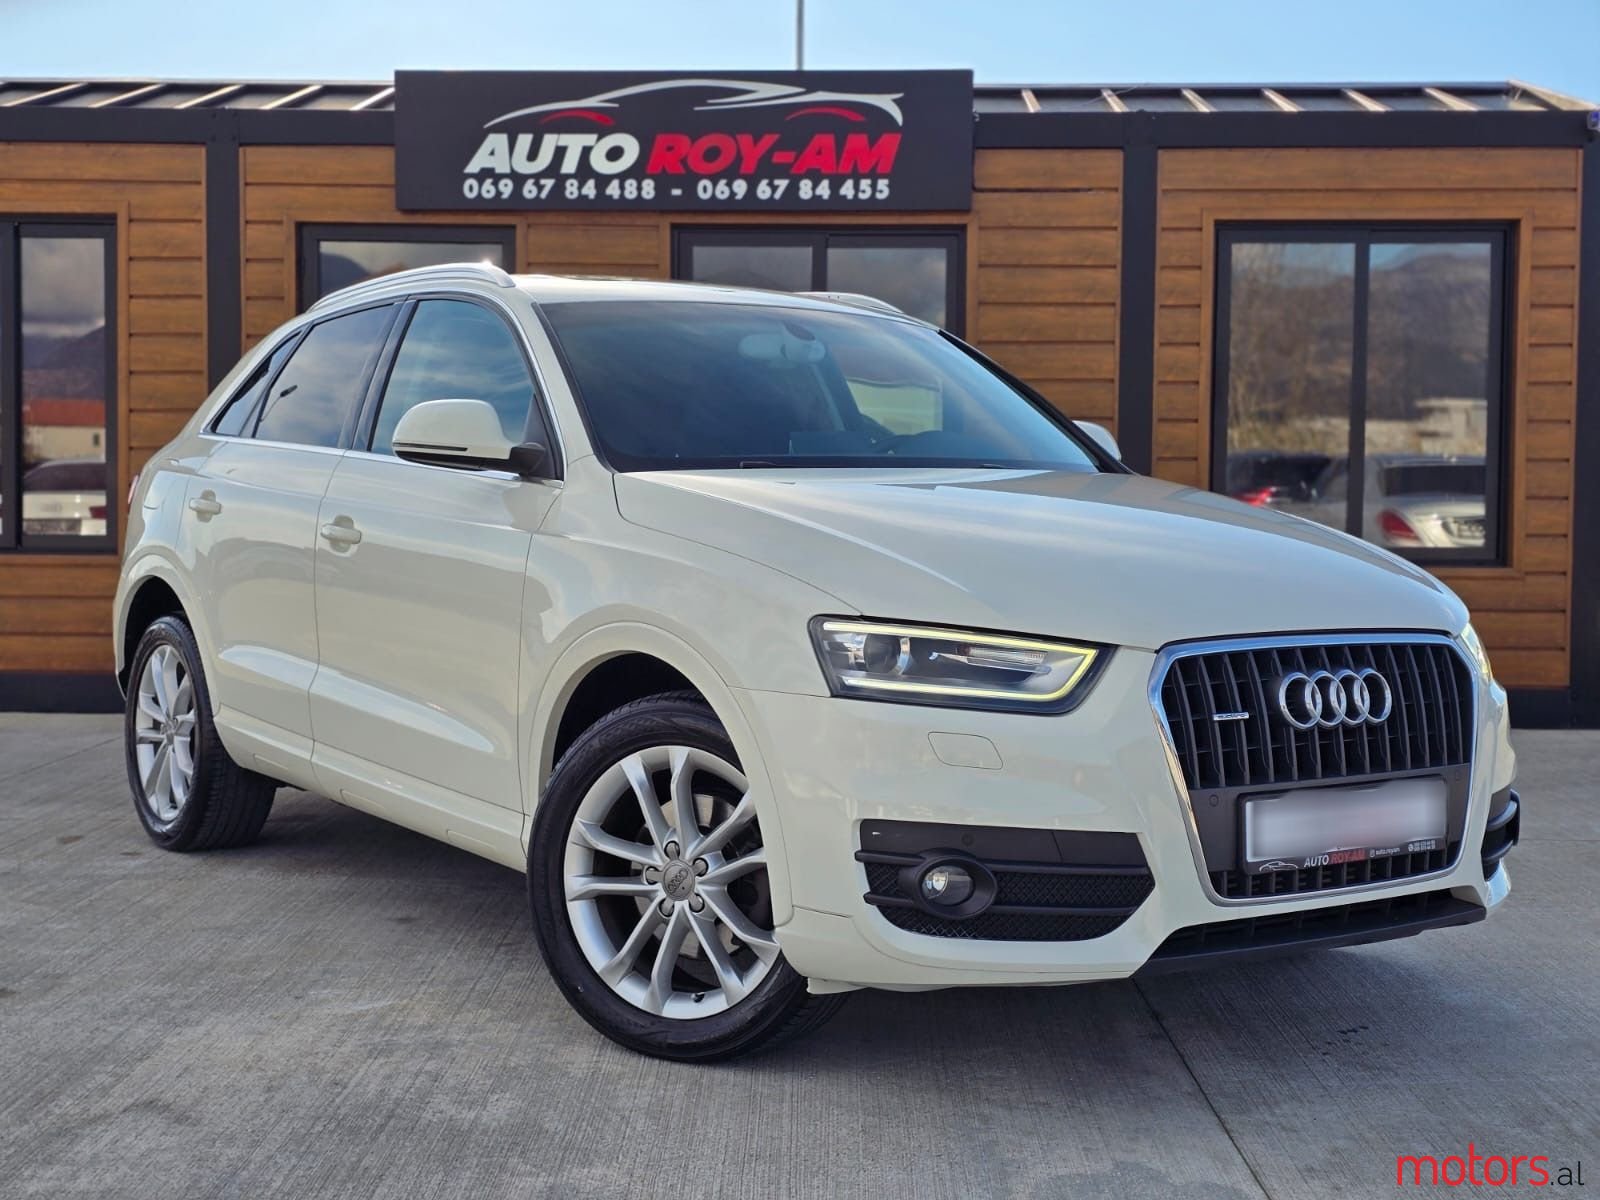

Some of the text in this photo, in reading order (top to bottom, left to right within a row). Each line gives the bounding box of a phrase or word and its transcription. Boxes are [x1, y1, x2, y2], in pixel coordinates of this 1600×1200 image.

[463, 132, 902, 175] AUTO ROY-AM
[463, 178, 514, 200] 069
[522, 178, 556, 200] 67
[565, 178, 597, 200] 84
[605, 178, 656, 200] 488
[697, 178, 748, 200] 069
[756, 178, 790, 200] 67
[798, 178, 831, 200] 84
[839, 178, 890, 200] 455
[1304, 854, 1329, 868] AUTO
